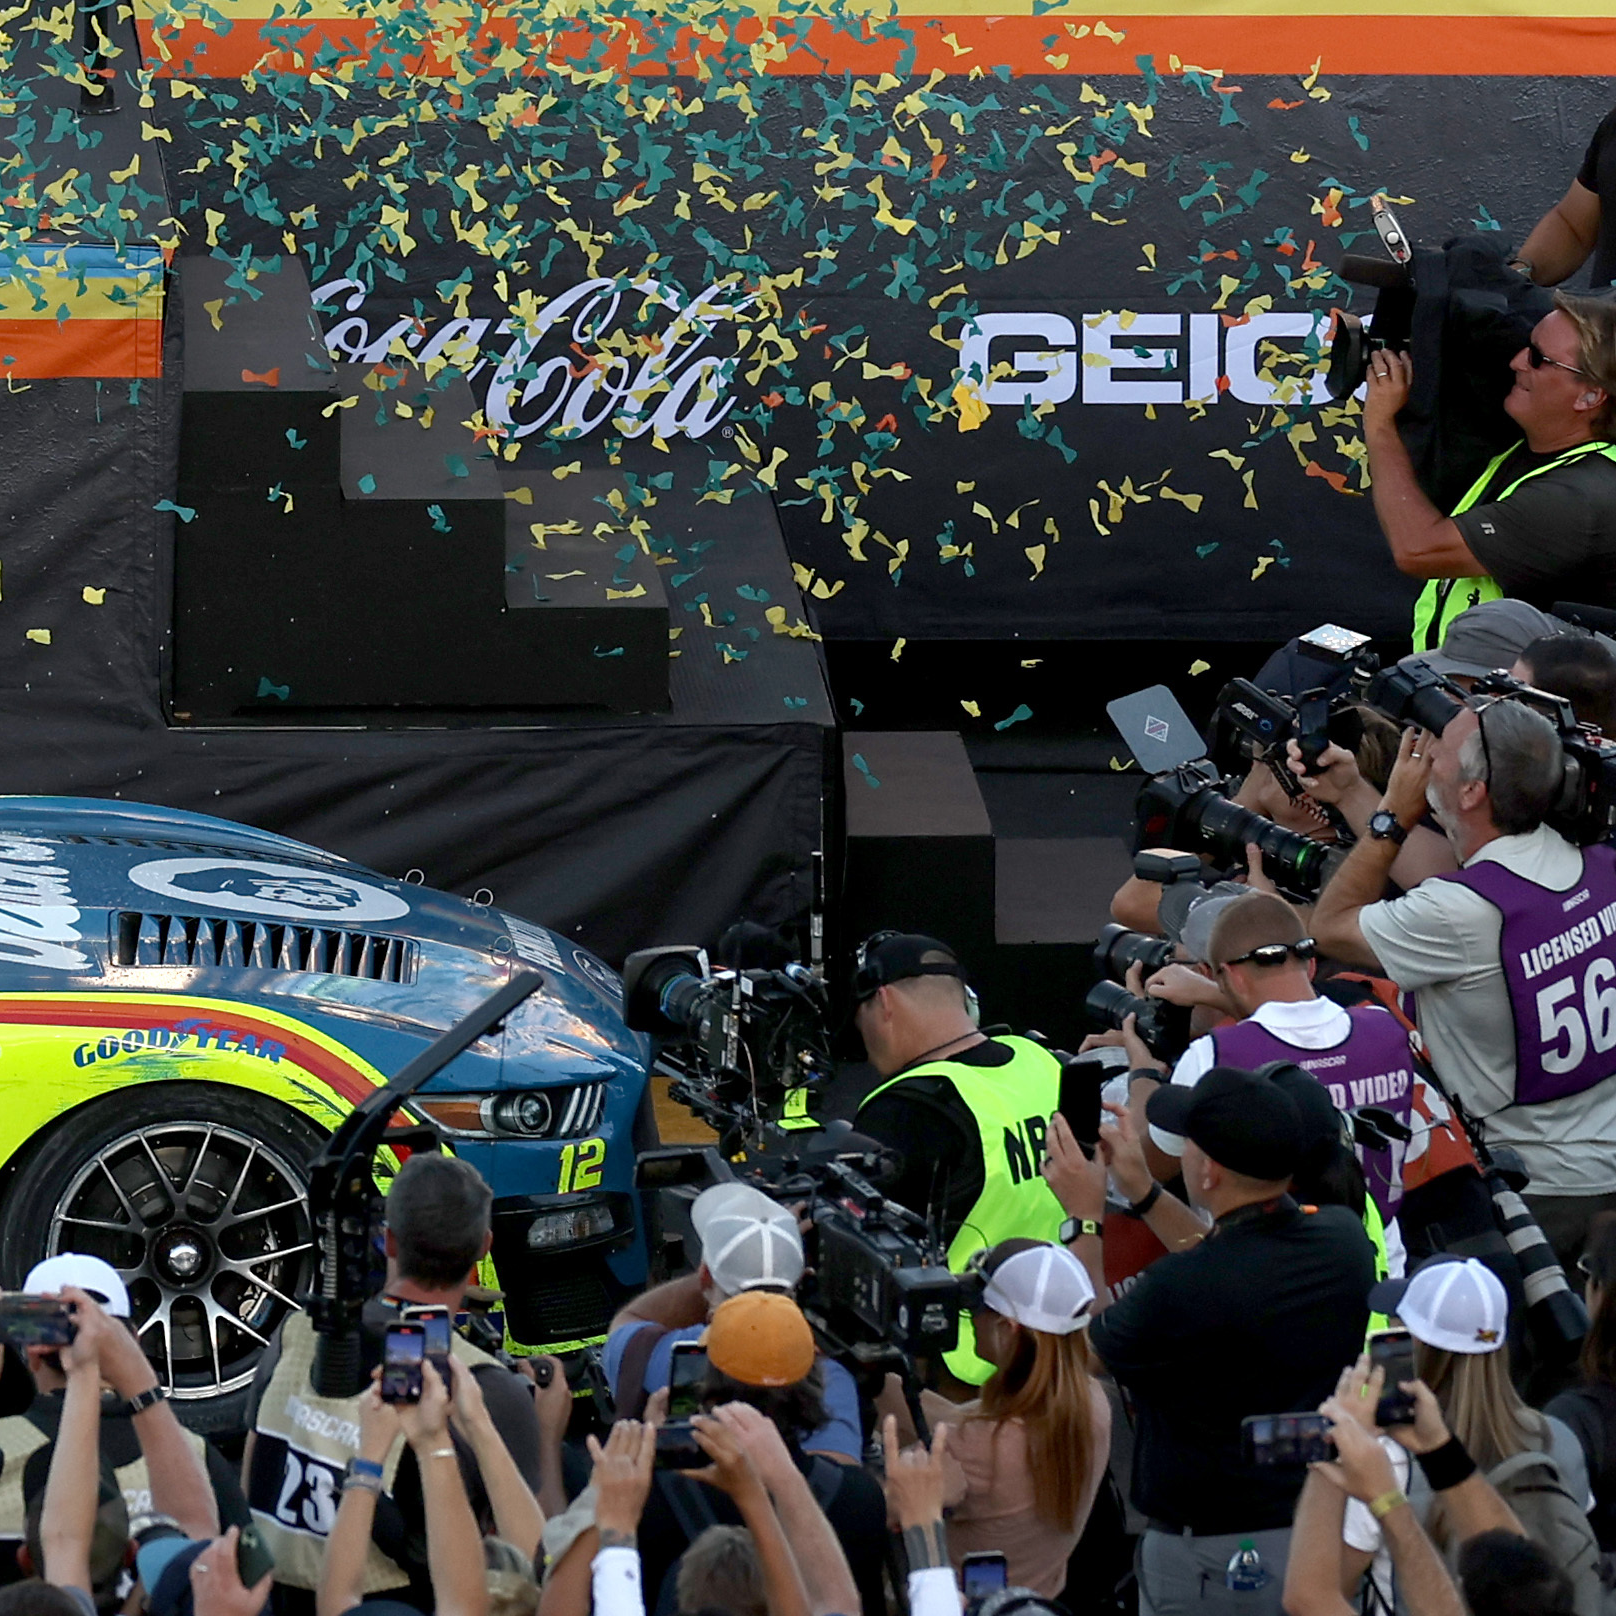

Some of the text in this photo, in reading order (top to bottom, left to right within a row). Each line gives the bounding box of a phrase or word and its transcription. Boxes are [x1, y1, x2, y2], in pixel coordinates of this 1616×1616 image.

[961, 311, 1367, 406] GEIC
[1519, 915, 1602, 980] LICENSED
[72, 1026, 287, 1068] GOODYEAR
[1349, 1068, 1409, 1108] VIDEO
[557, 1137, 605, 1194] 12
[275, 1450, 338, 1534] 23
